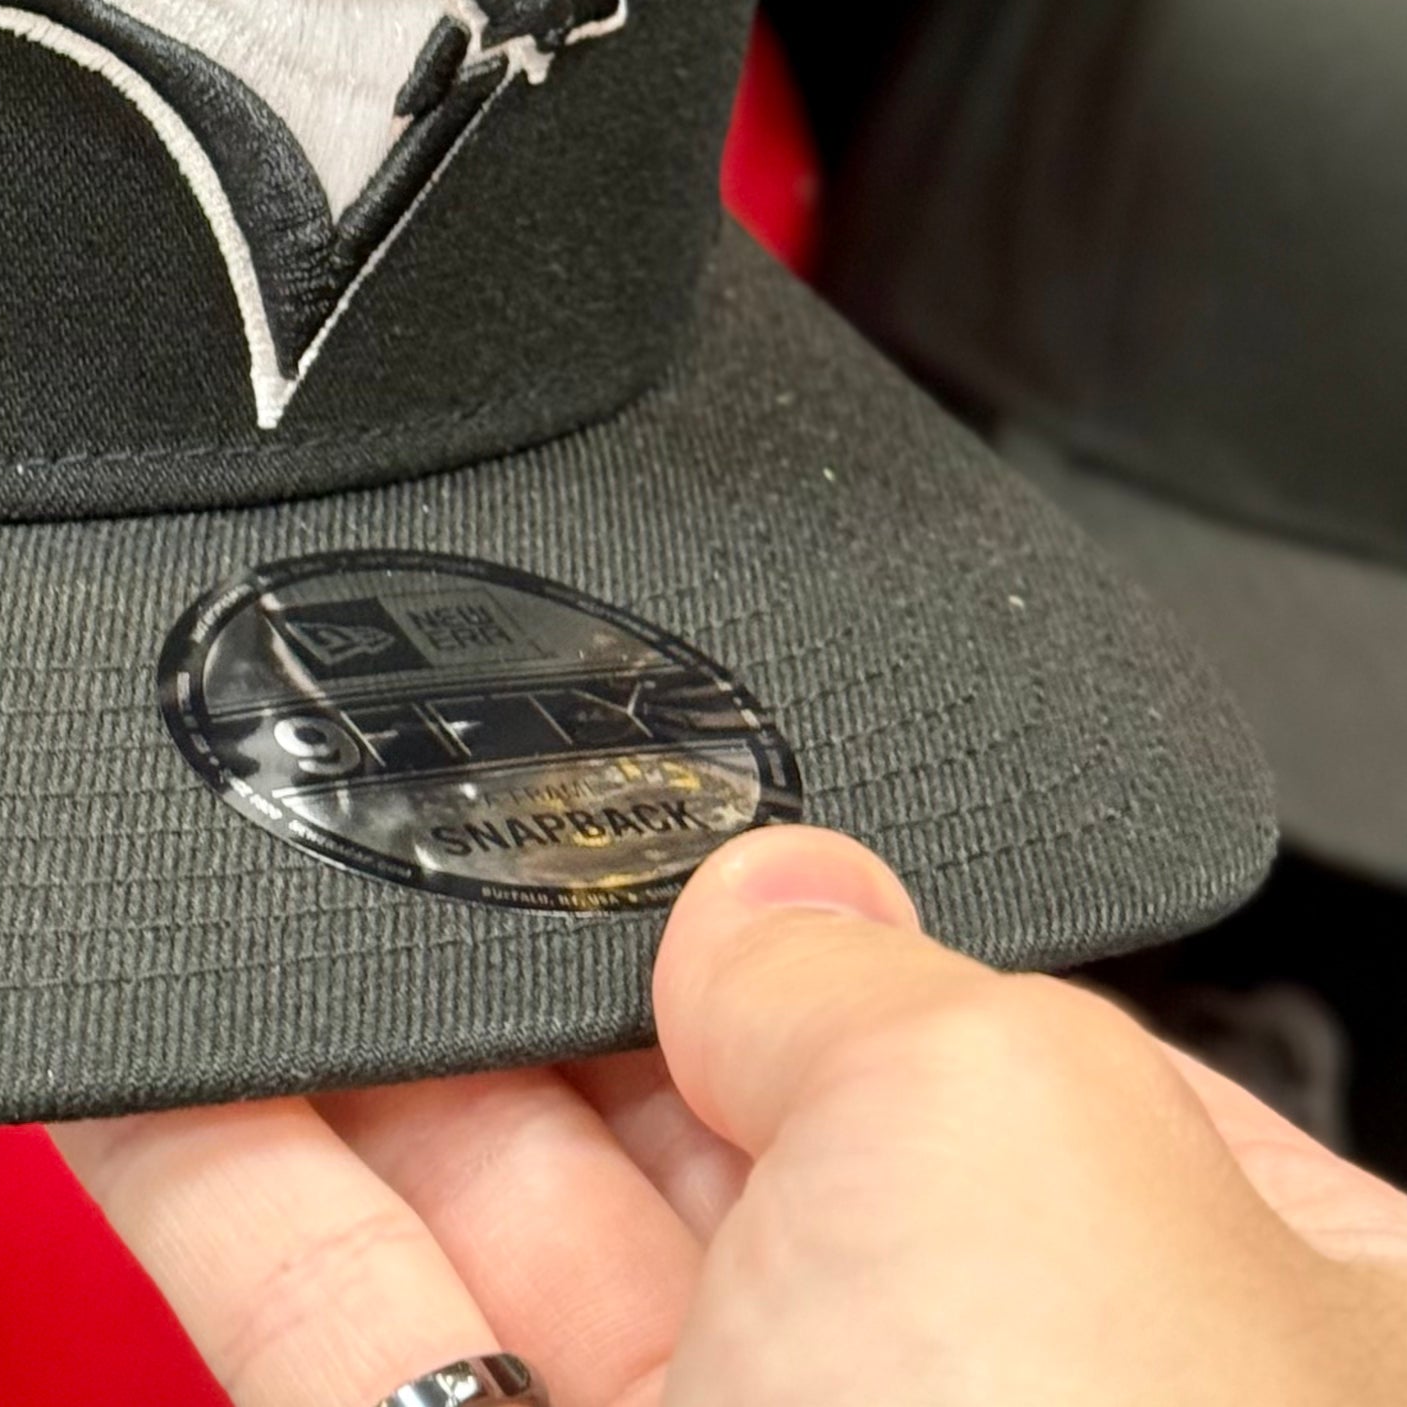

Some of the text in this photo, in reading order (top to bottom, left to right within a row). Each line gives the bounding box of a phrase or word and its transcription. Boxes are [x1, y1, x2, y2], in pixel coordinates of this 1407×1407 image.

[406, 602, 493, 633] NEW
[428, 624, 513, 652] ERA
[432, 799, 710, 857] SNAPBACK
